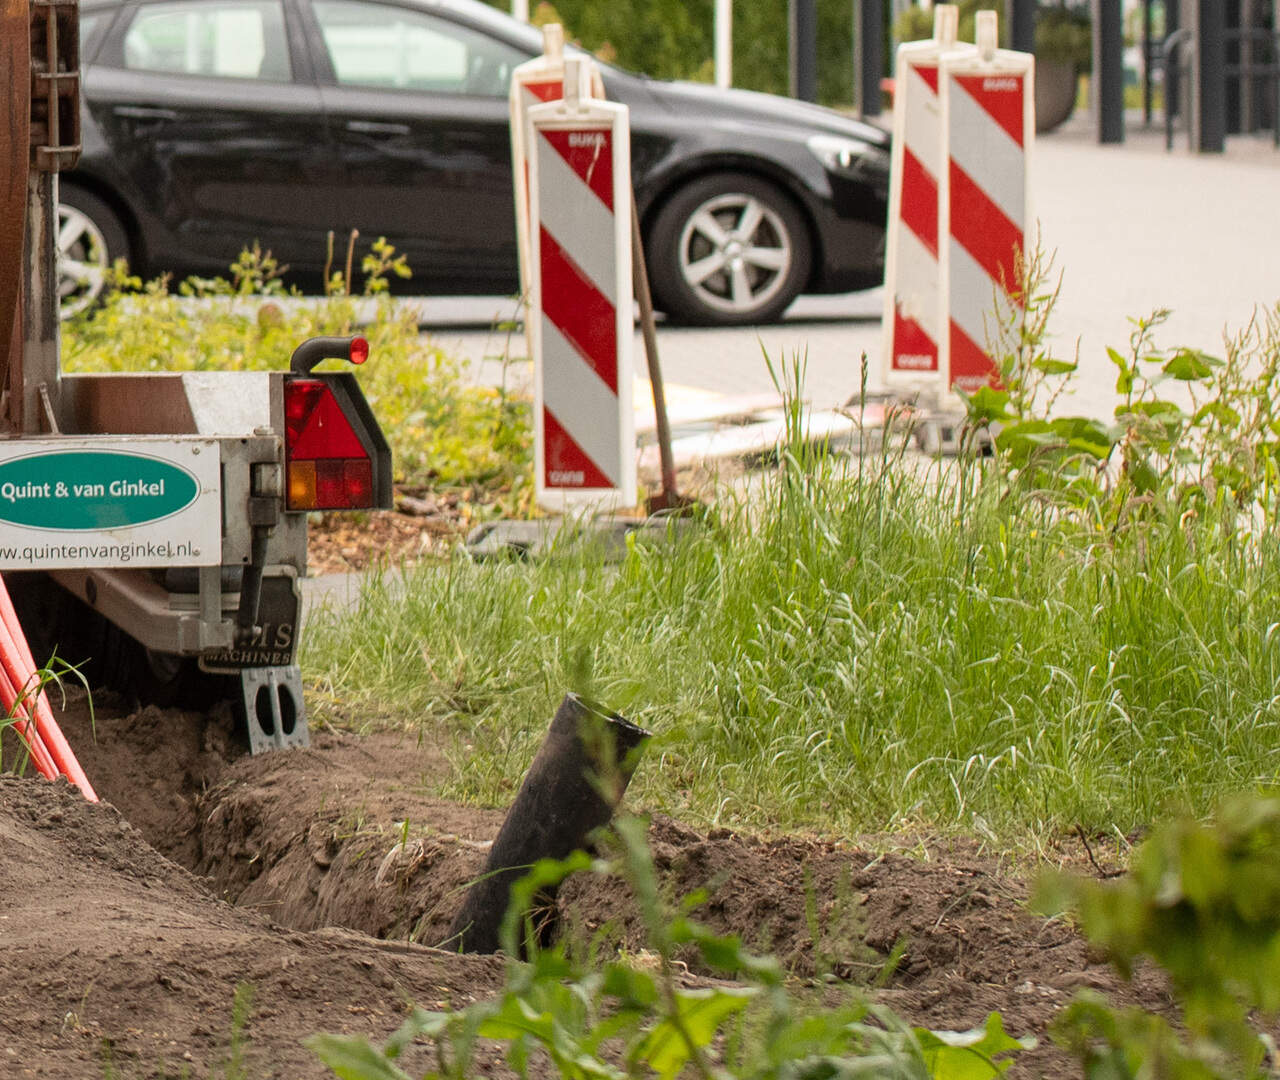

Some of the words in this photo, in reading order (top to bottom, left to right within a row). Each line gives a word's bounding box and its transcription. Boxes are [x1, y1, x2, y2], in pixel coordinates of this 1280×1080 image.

[1, 482, 50, 503] Quint
[54, 481, 69, 497] &
[74, 484, 104, 497] van
[109, 479, 165, 497] Ginkel
